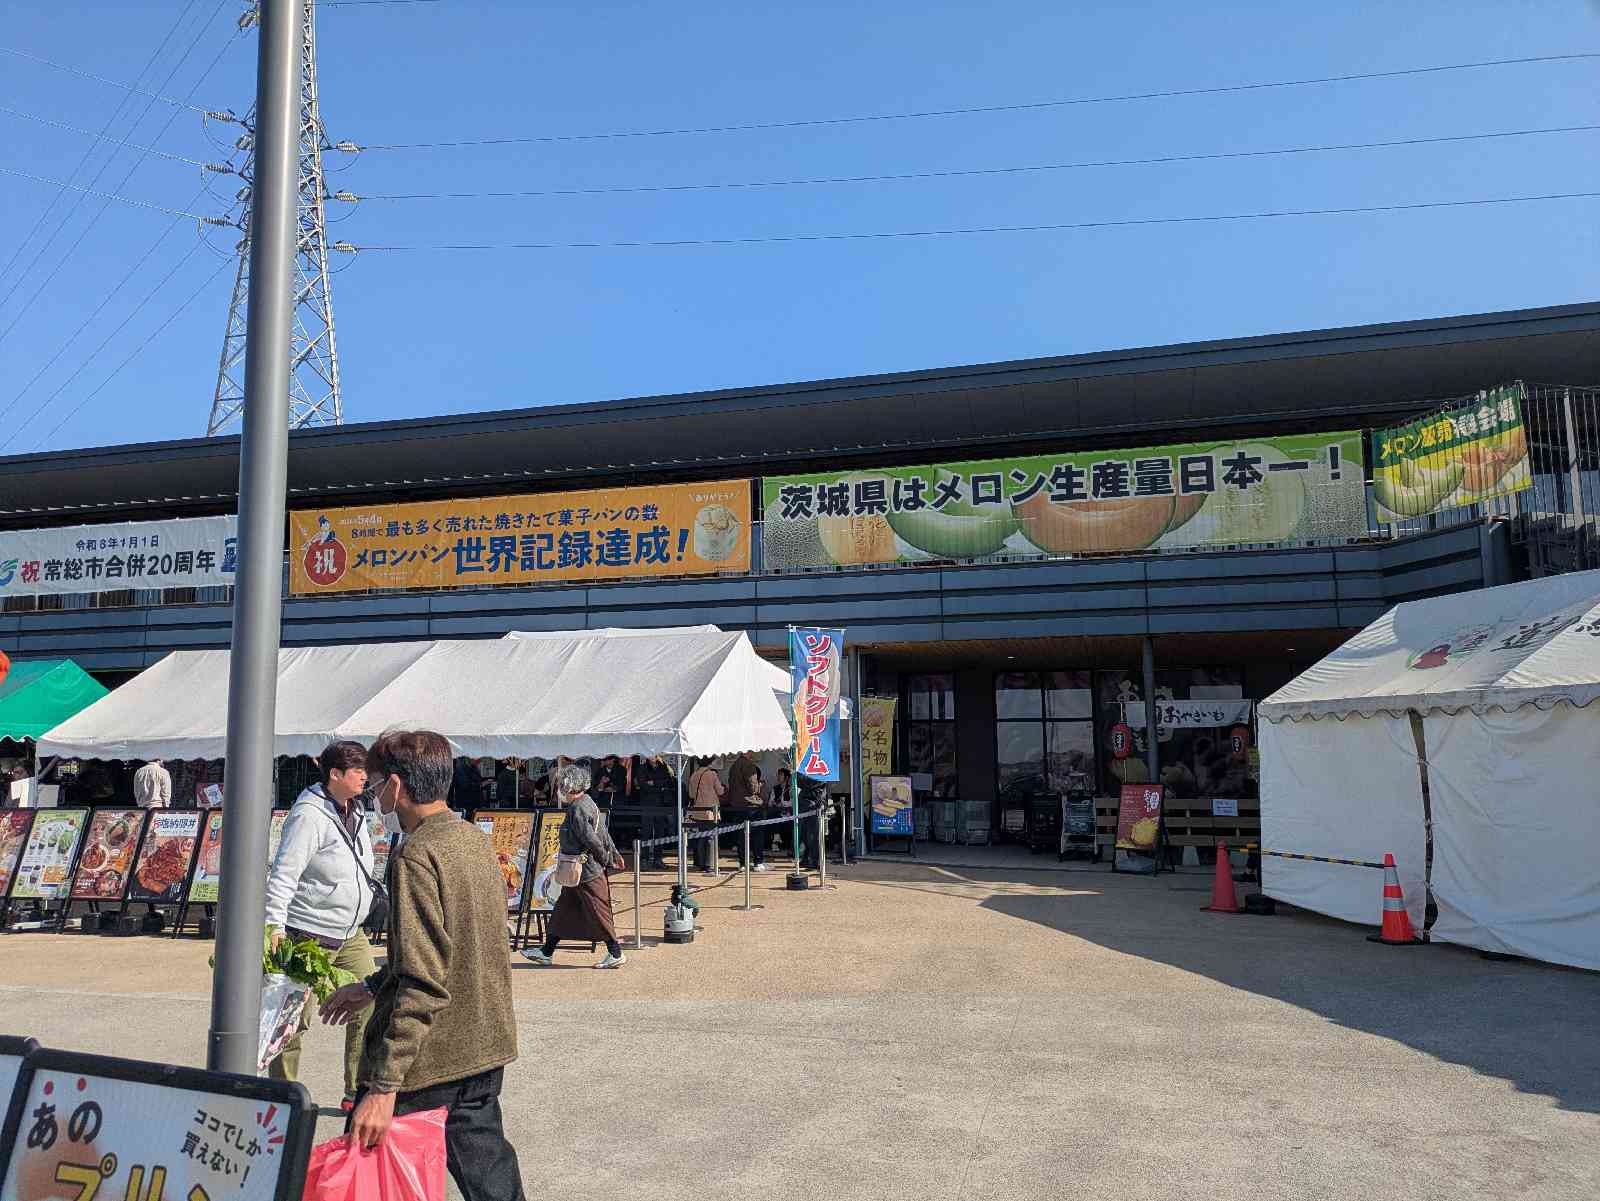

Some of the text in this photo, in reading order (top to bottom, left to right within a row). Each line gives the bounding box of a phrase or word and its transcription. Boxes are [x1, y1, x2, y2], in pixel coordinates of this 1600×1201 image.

[779, 446, 1342, 518] 茨城県はメロン生産量日本一!
[351, 527, 690, 575] メロンパン世界記録達成!
[805, 634, 831, 776] ソフトクリーム
[27, 1100, 103, 1151] あの
[193, 1108, 263, 1158] ココでしか
[55, 1152, 212, 1201] プリ
[180, 1131, 251, 1188] 買えない!
